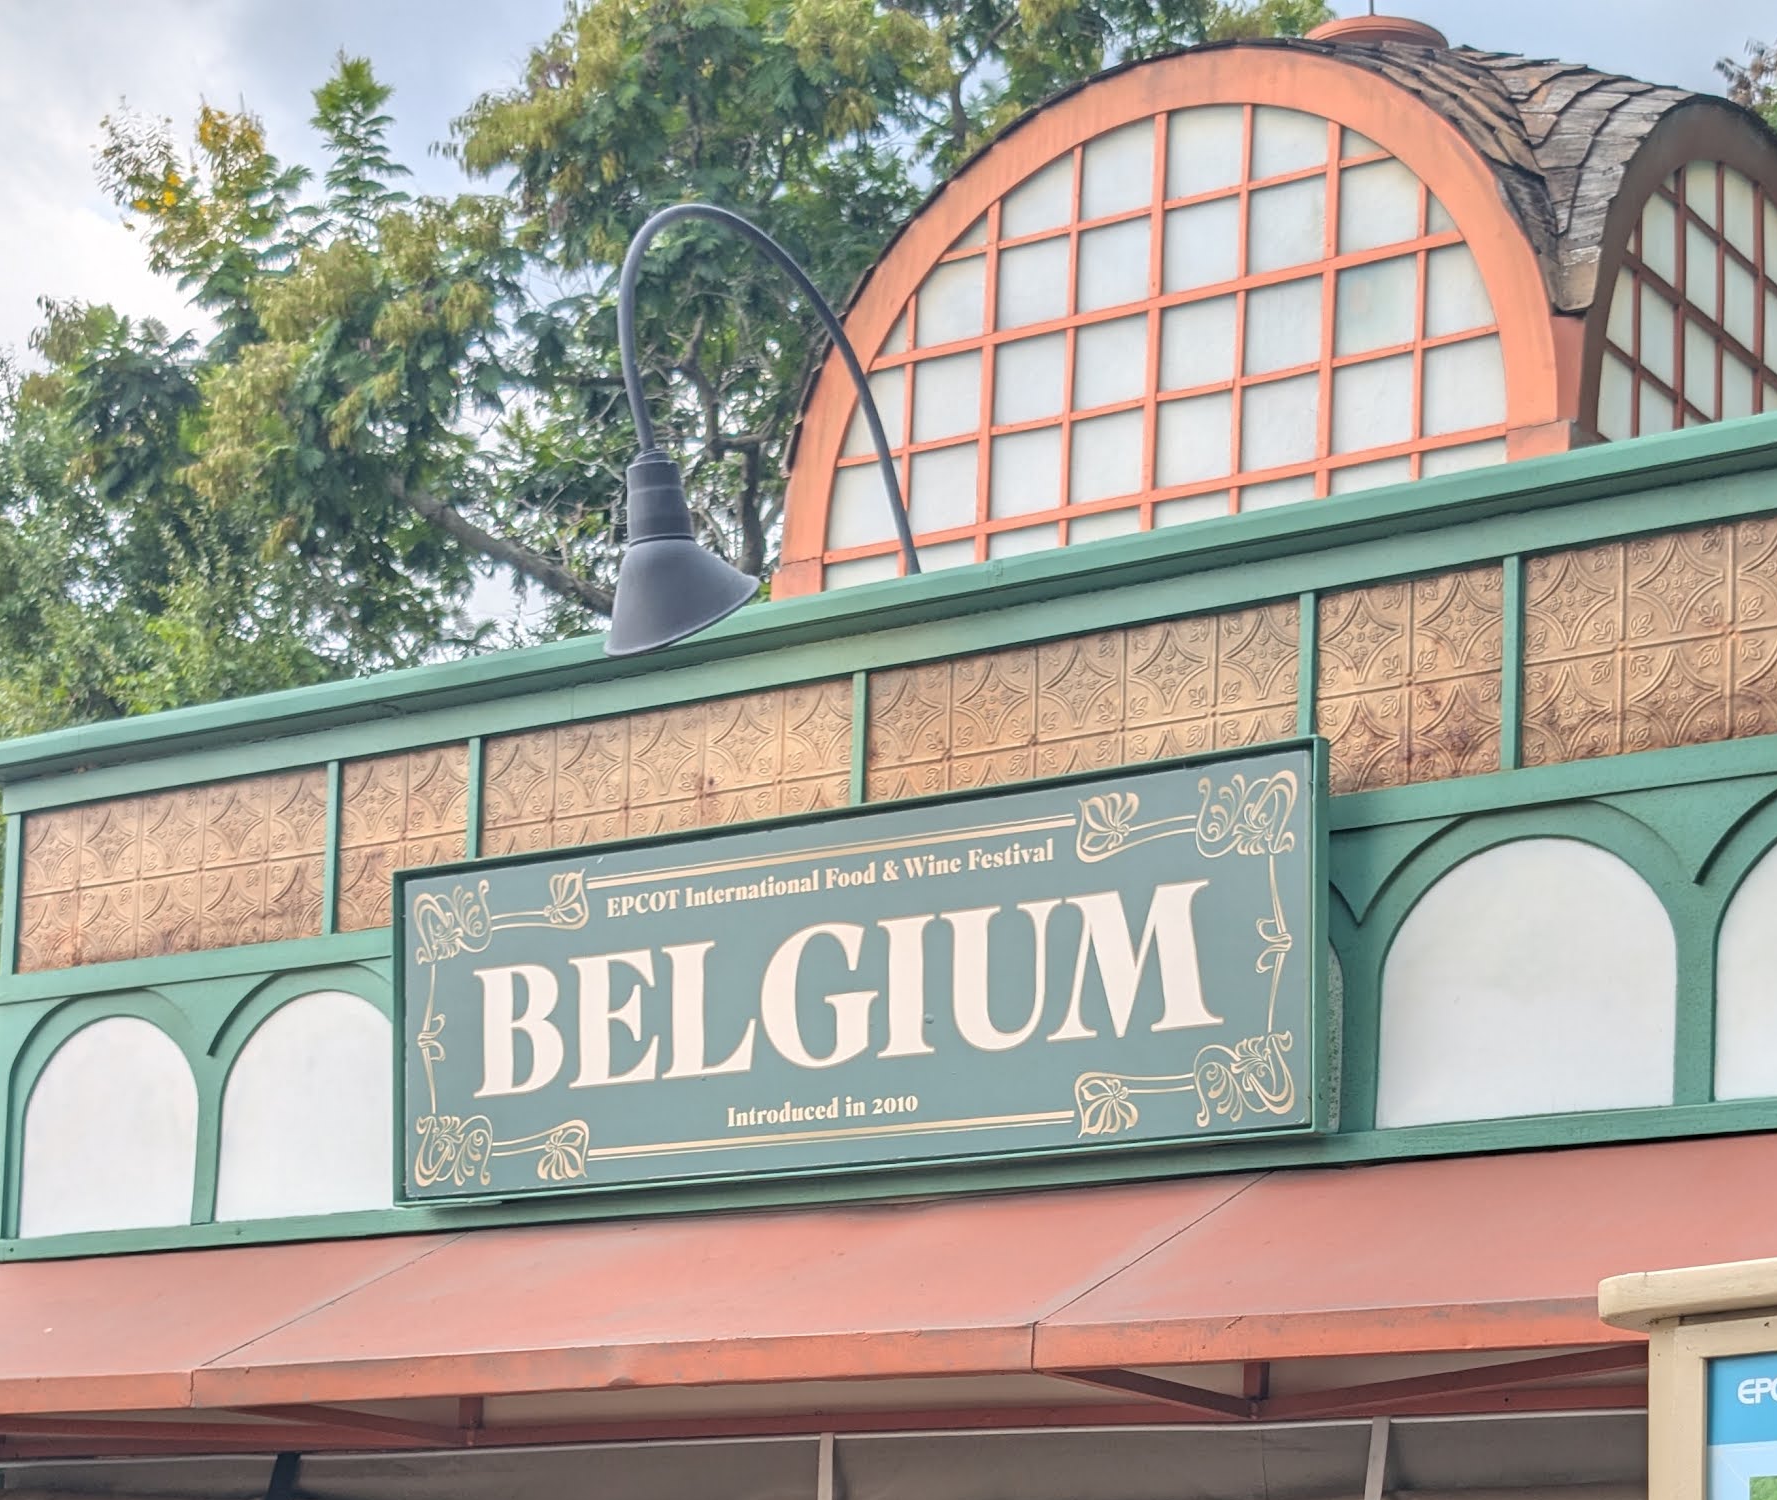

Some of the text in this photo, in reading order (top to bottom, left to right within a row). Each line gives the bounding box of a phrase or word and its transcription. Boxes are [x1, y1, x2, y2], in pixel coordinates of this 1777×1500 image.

[606, 838, 1054, 918] EPCOT International Food & Wine Festival
[473, 880, 1223, 1100] BELGIUM
[727, 1097, 918, 1128] Introduced in 2010
